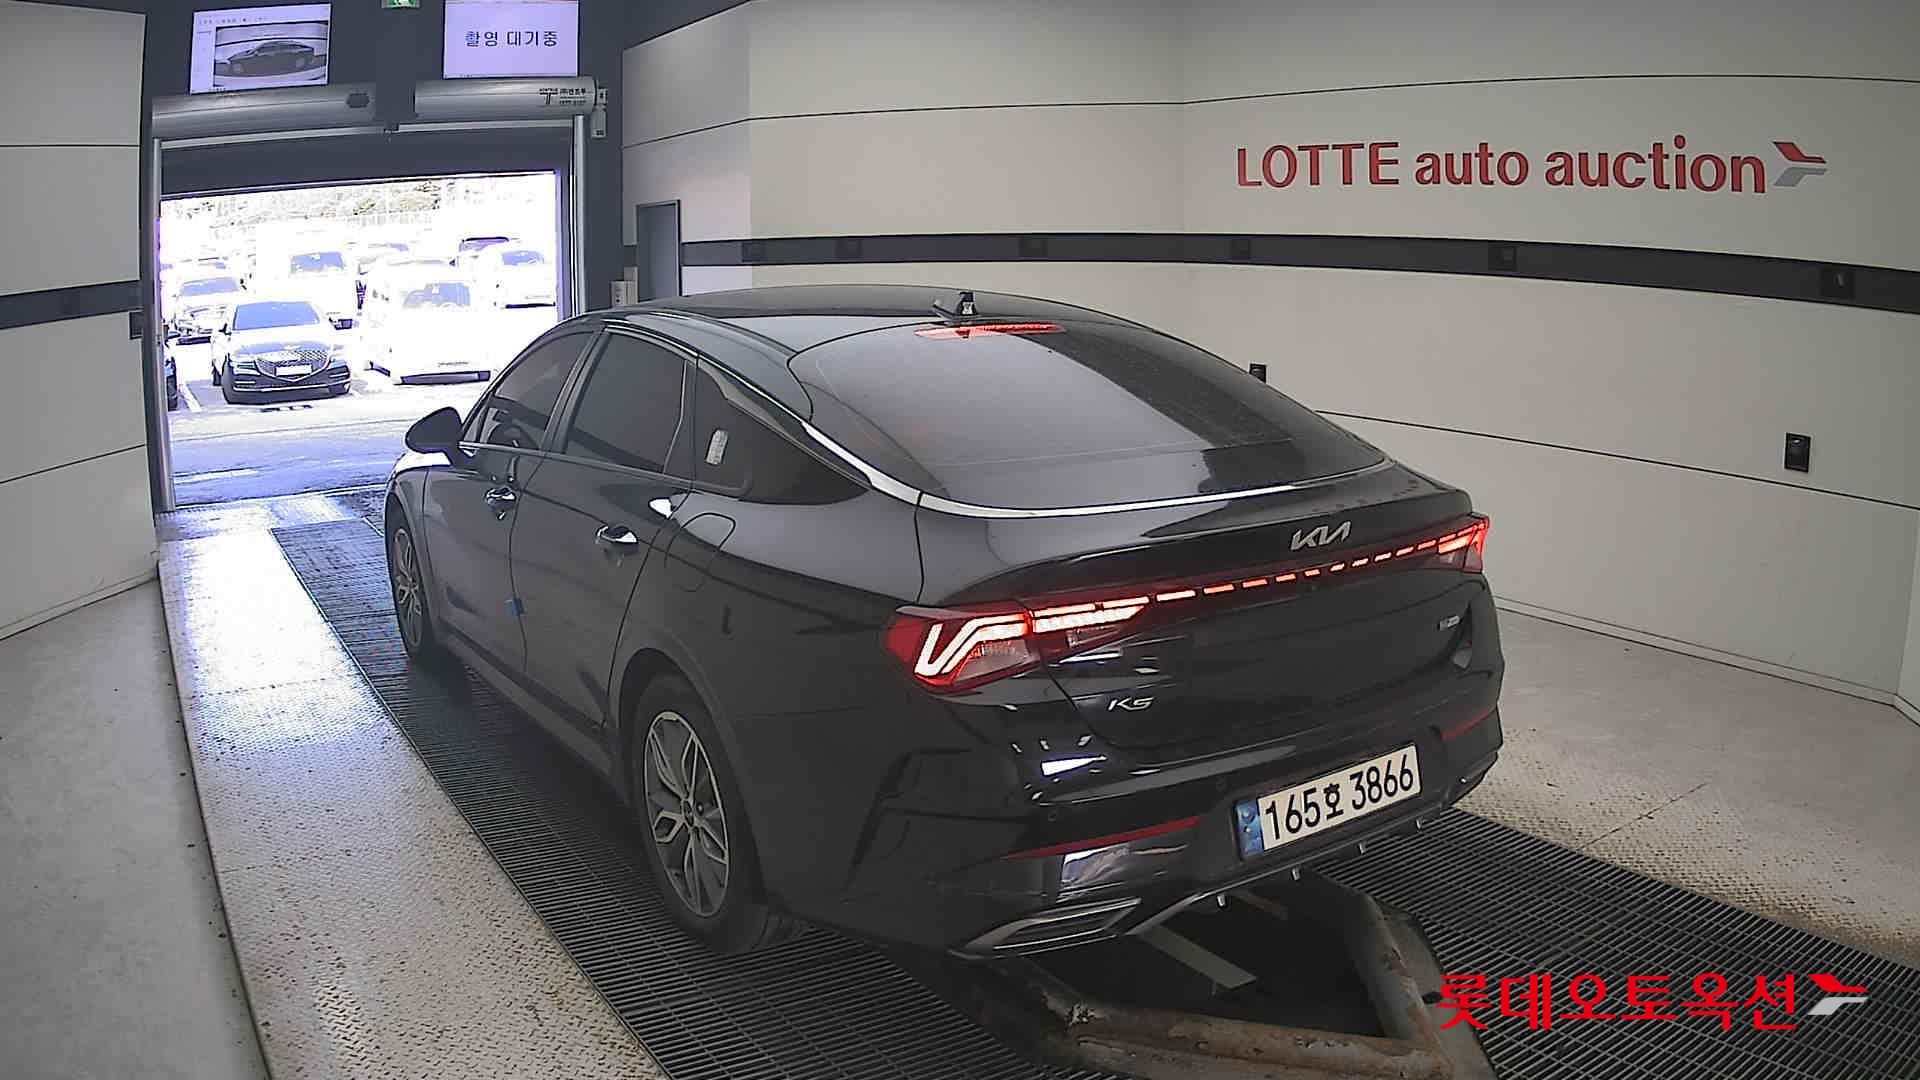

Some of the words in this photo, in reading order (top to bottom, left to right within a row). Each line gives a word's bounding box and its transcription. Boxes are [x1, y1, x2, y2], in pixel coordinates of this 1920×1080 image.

[506, 30, 558, 47] 대기중
[1237, 141, 1400, 188] LOTTE
[1415, 142, 1529, 186] auto
[1544, 134, 1767, 194] auction
[1265, 783, 1344, 840] 165호
[1349, 754, 1414, 810] 3866
